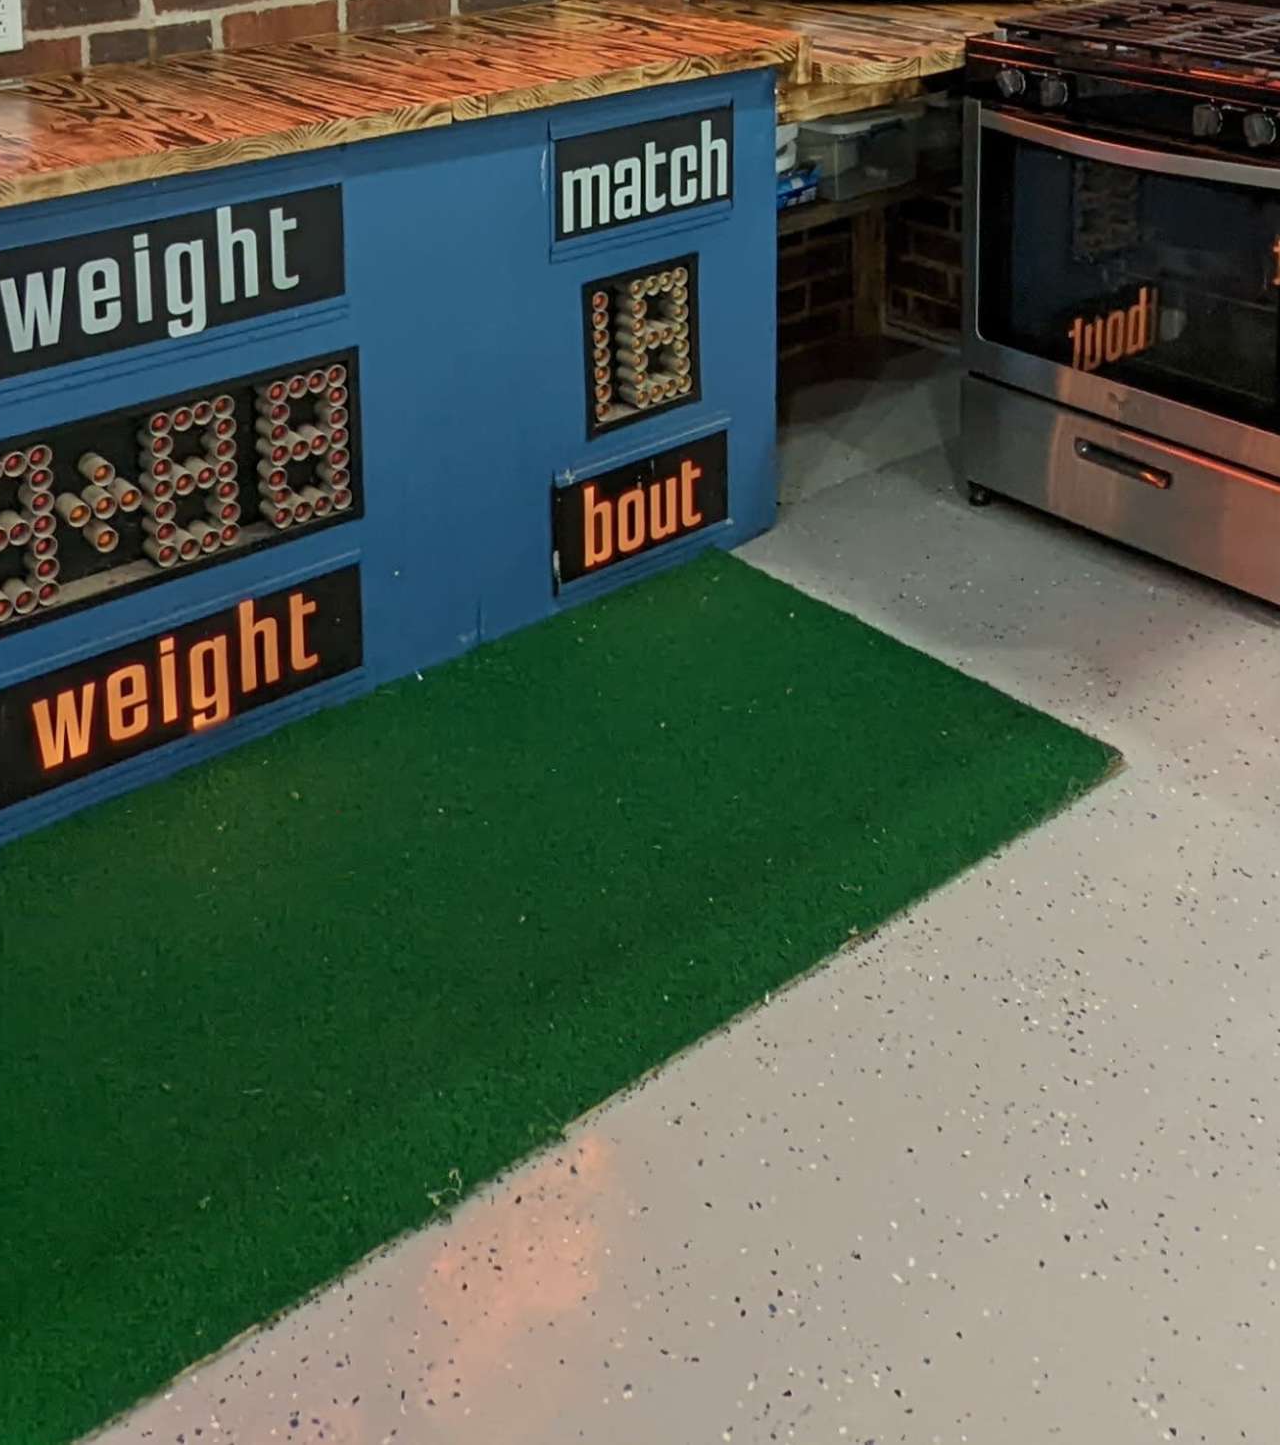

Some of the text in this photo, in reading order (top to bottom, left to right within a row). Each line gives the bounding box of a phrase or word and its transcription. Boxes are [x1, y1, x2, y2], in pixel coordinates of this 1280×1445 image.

[561, 119, 728, 234] match
[582, 459, 703, 569] bout
[30, 591, 320, 771] weight
